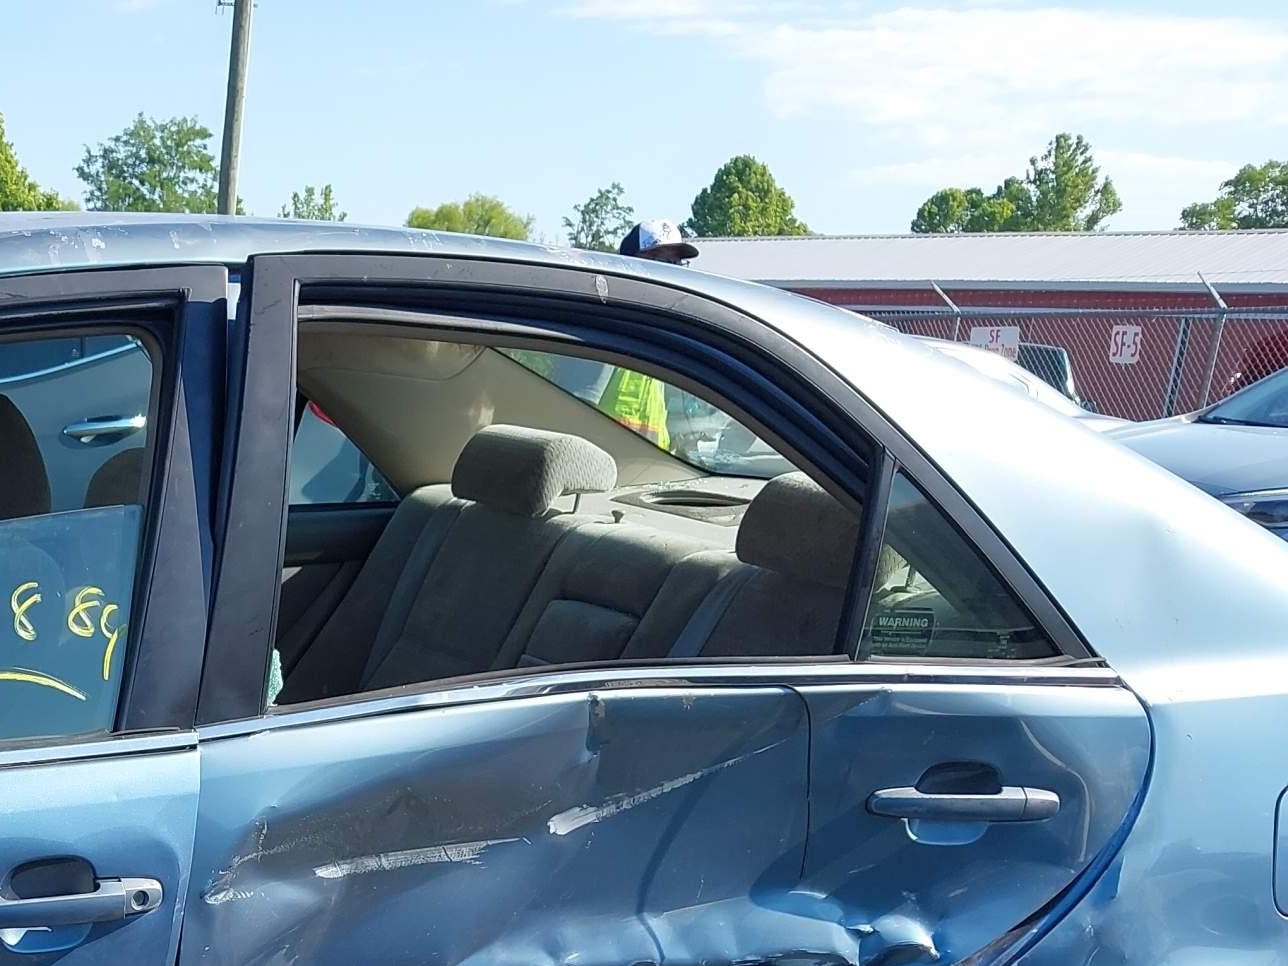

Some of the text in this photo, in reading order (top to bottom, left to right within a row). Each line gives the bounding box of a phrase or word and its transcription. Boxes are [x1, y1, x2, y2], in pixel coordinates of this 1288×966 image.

[988, 329, 1001, 344] SF
[1112, 329, 1140, 358] SF-5
[878, 616, 929, 628] WARNING
